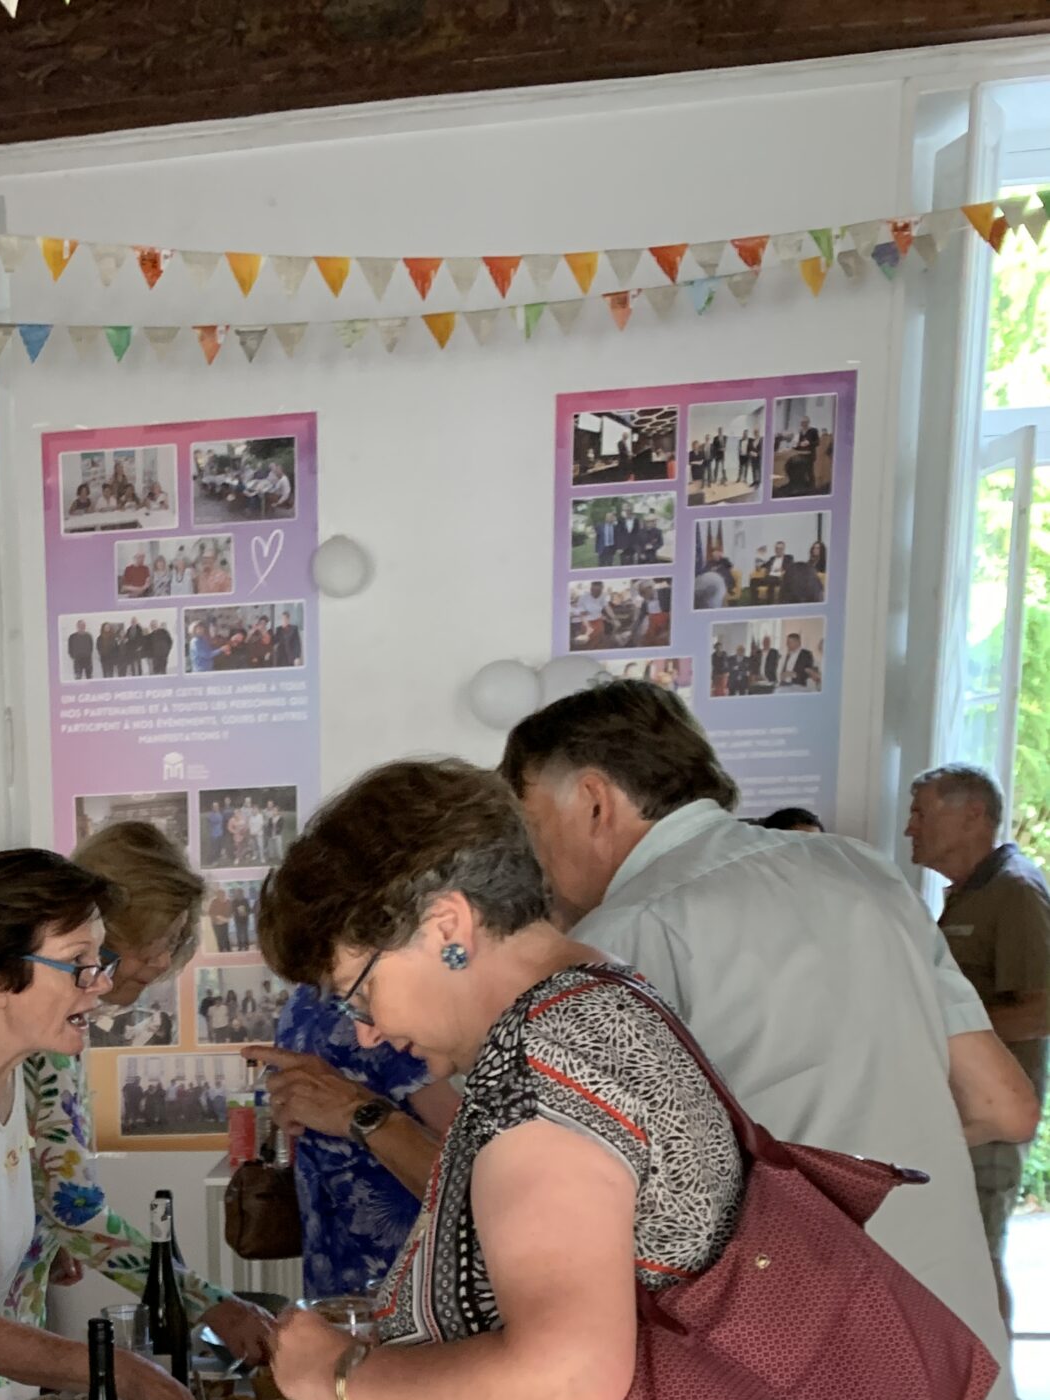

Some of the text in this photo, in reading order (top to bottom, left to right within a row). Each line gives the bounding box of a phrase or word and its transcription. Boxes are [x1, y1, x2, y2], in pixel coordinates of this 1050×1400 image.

[77, 692, 112, 704] GRAND
[113, 690, 143, 702] MERCI
[145, 688, 174, 700] POUR
[175, 686, 204, 698] CETTE
[206, 684, 233, 696] BELLE
[279, 680, 307, 691] TOUS
[60, 708, 82, 719] NOS
[83, 704, 146, 718] PARTENAIRES
[148, 703, 160, 714] ET
[288, 695, 310, 706] QUI
[61, 721, 121, 734] PARTICIPENT
[133, 719, 154, 730] NOS
[257, 712, 270, 723] ET
[271, 710, 309, 723] AUTRES
